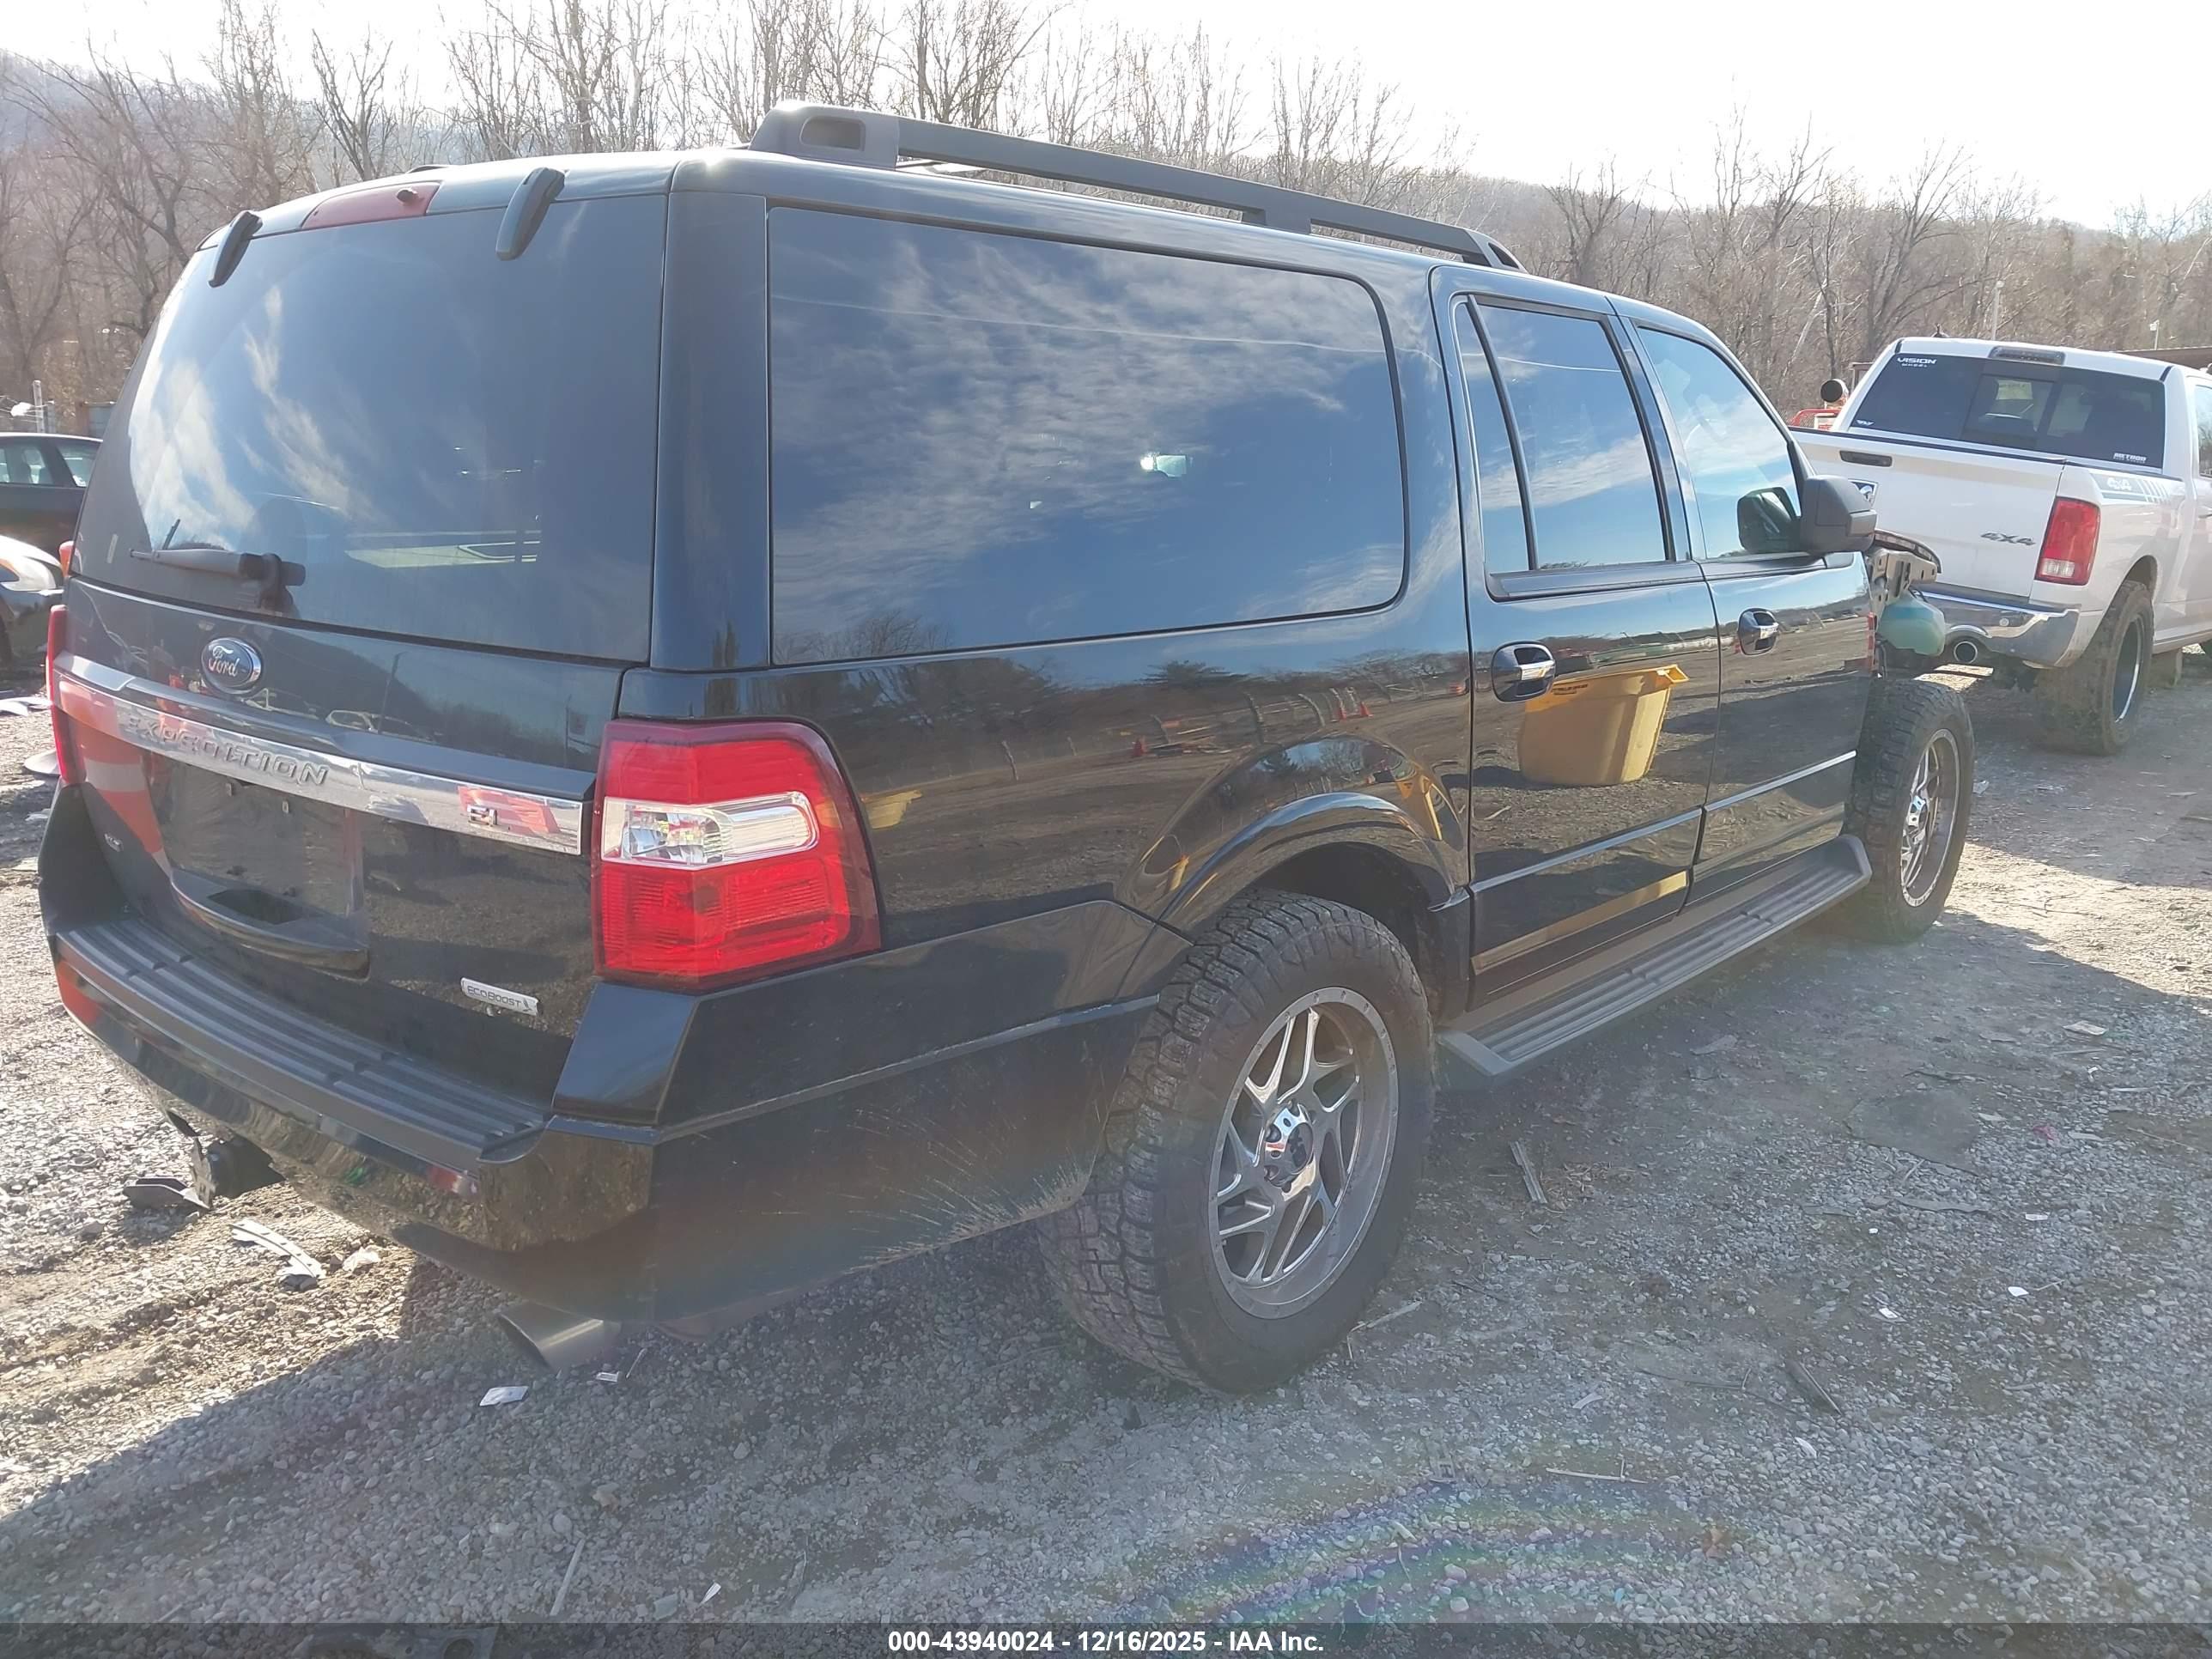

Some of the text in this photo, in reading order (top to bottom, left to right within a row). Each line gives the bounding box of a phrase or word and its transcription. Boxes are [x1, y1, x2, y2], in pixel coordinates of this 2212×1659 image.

[208, 645, 240, 678] Ford
[127, 716, 329, 786] EXPEDITION
[466, 985, 522, 1008] ECOBOOST
